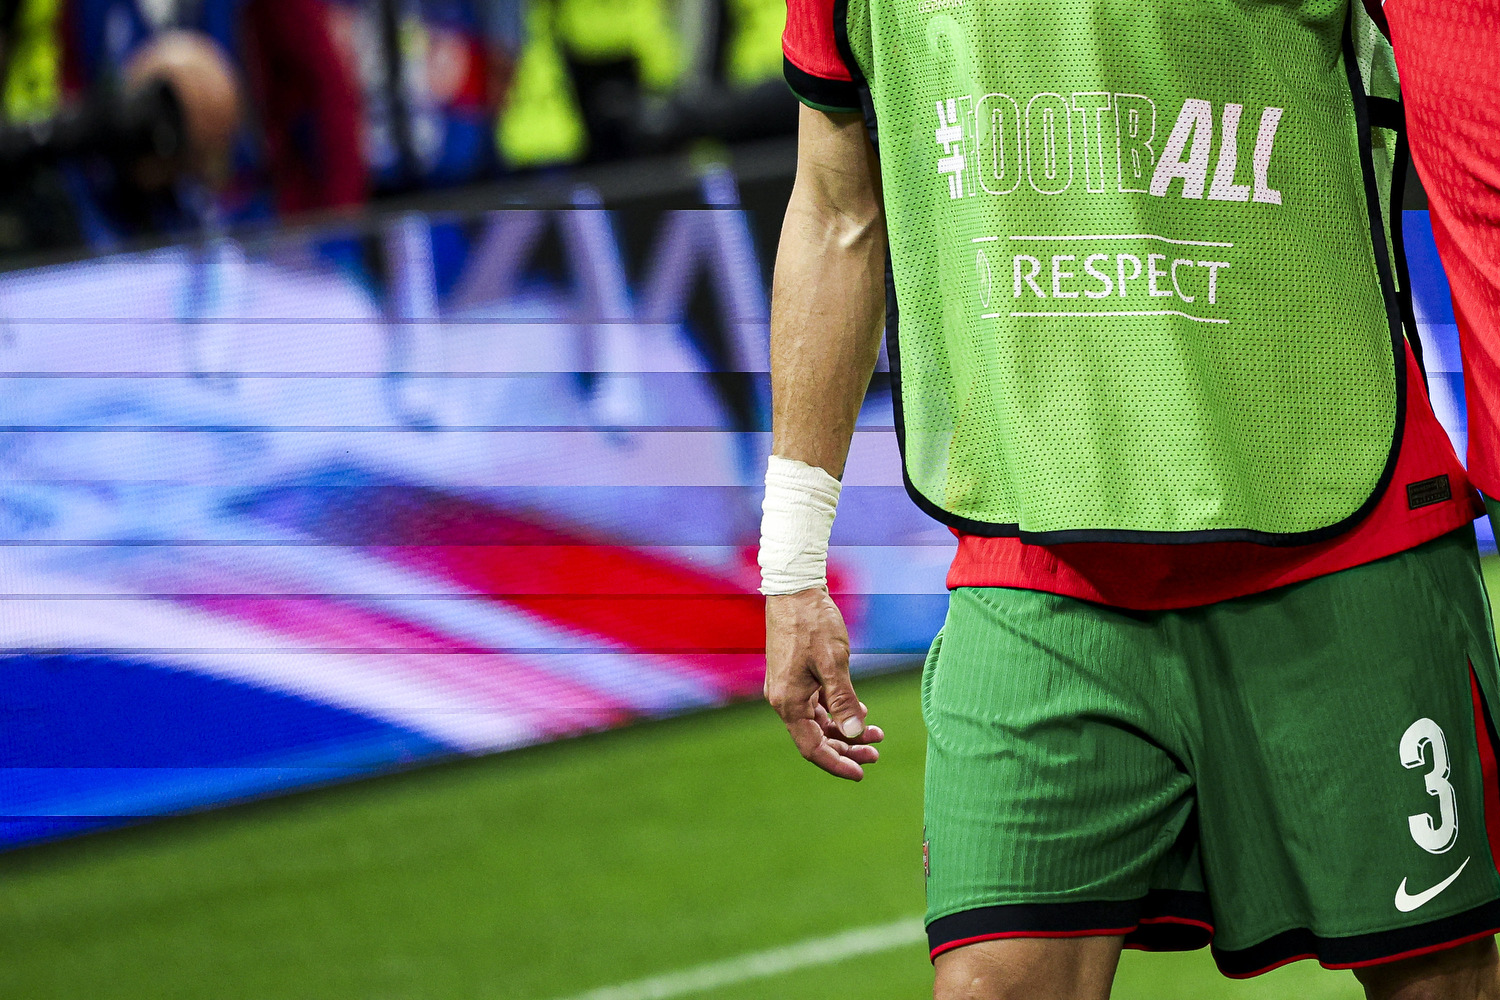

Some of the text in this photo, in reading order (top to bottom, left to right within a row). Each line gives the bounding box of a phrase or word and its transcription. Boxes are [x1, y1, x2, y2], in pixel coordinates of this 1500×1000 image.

[935, 92, 1284, 205] #FOOTBALL
[1012, 252, 1231, 305] RESPECT
[1399, 717, 1458, 854] 3
